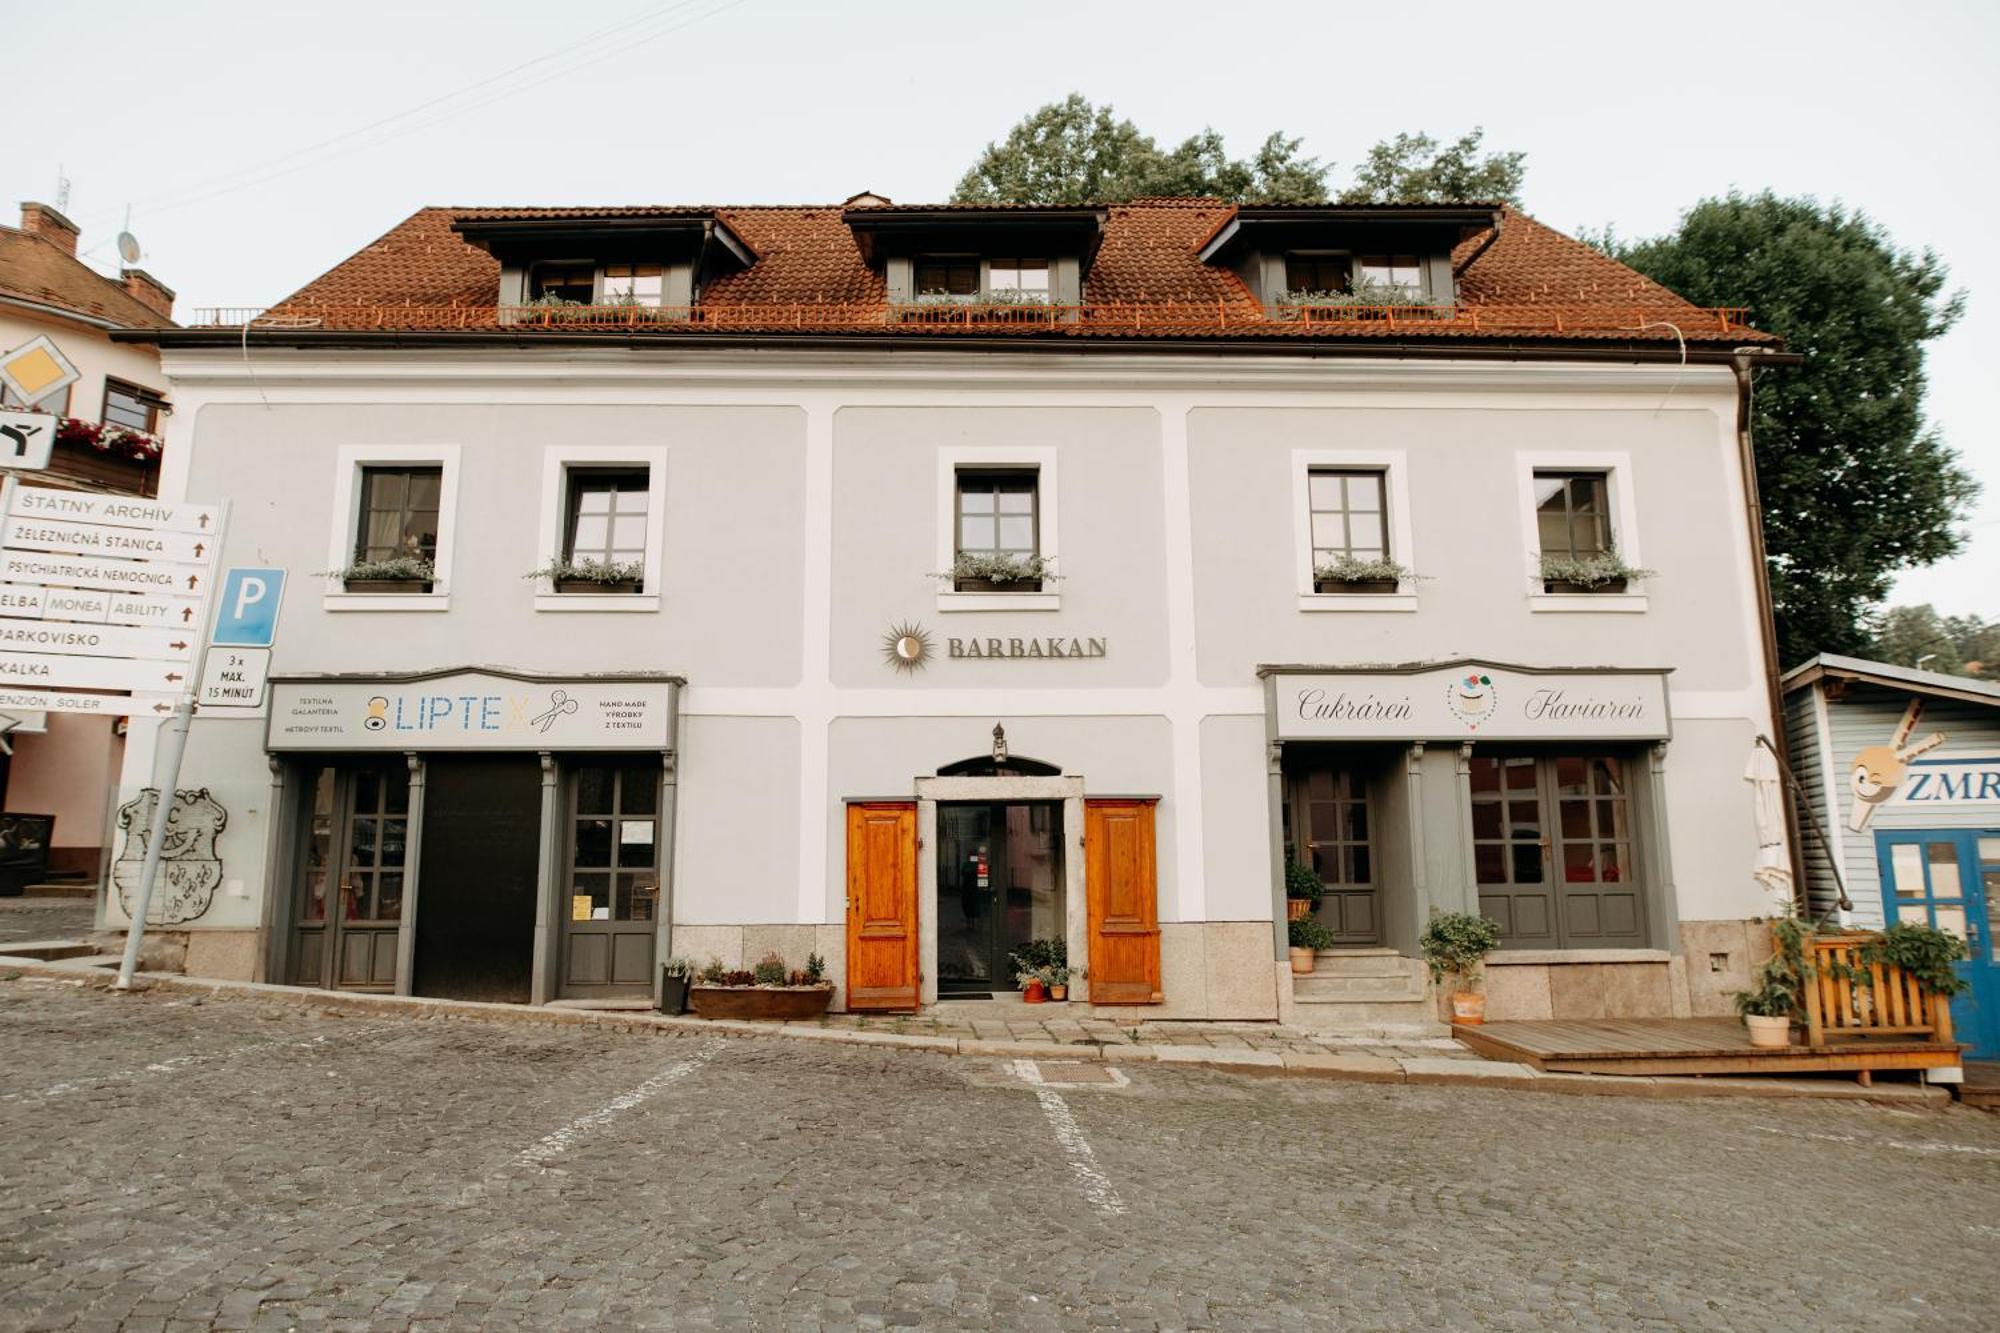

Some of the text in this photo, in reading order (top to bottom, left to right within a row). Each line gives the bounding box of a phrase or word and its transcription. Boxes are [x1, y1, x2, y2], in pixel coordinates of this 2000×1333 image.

[15, 525, 163, 552] ŽELEZNIČNÁ STANICA
[8, 561, 173, 585] PSYCHIATRICKÁ NEMOCNICA
[234, 576, 266, 619] P
[50, 598, 102, 613] MONEA
[113, 602, 168, 616] ABILITY
[947, 637, 1107, 659] BARBAKAN
[229, 655, 236, 666] 3
[220, 671, 246, 682] MAX.
[208, 687, 219, 698] 15
[56, 698, 101, 709] SOLER
[396, 694, 530, 733] LIPTEX
[320, 725, 345, 733] TEXTIL
[605, 721, 642, 729] Z TEXTILU
